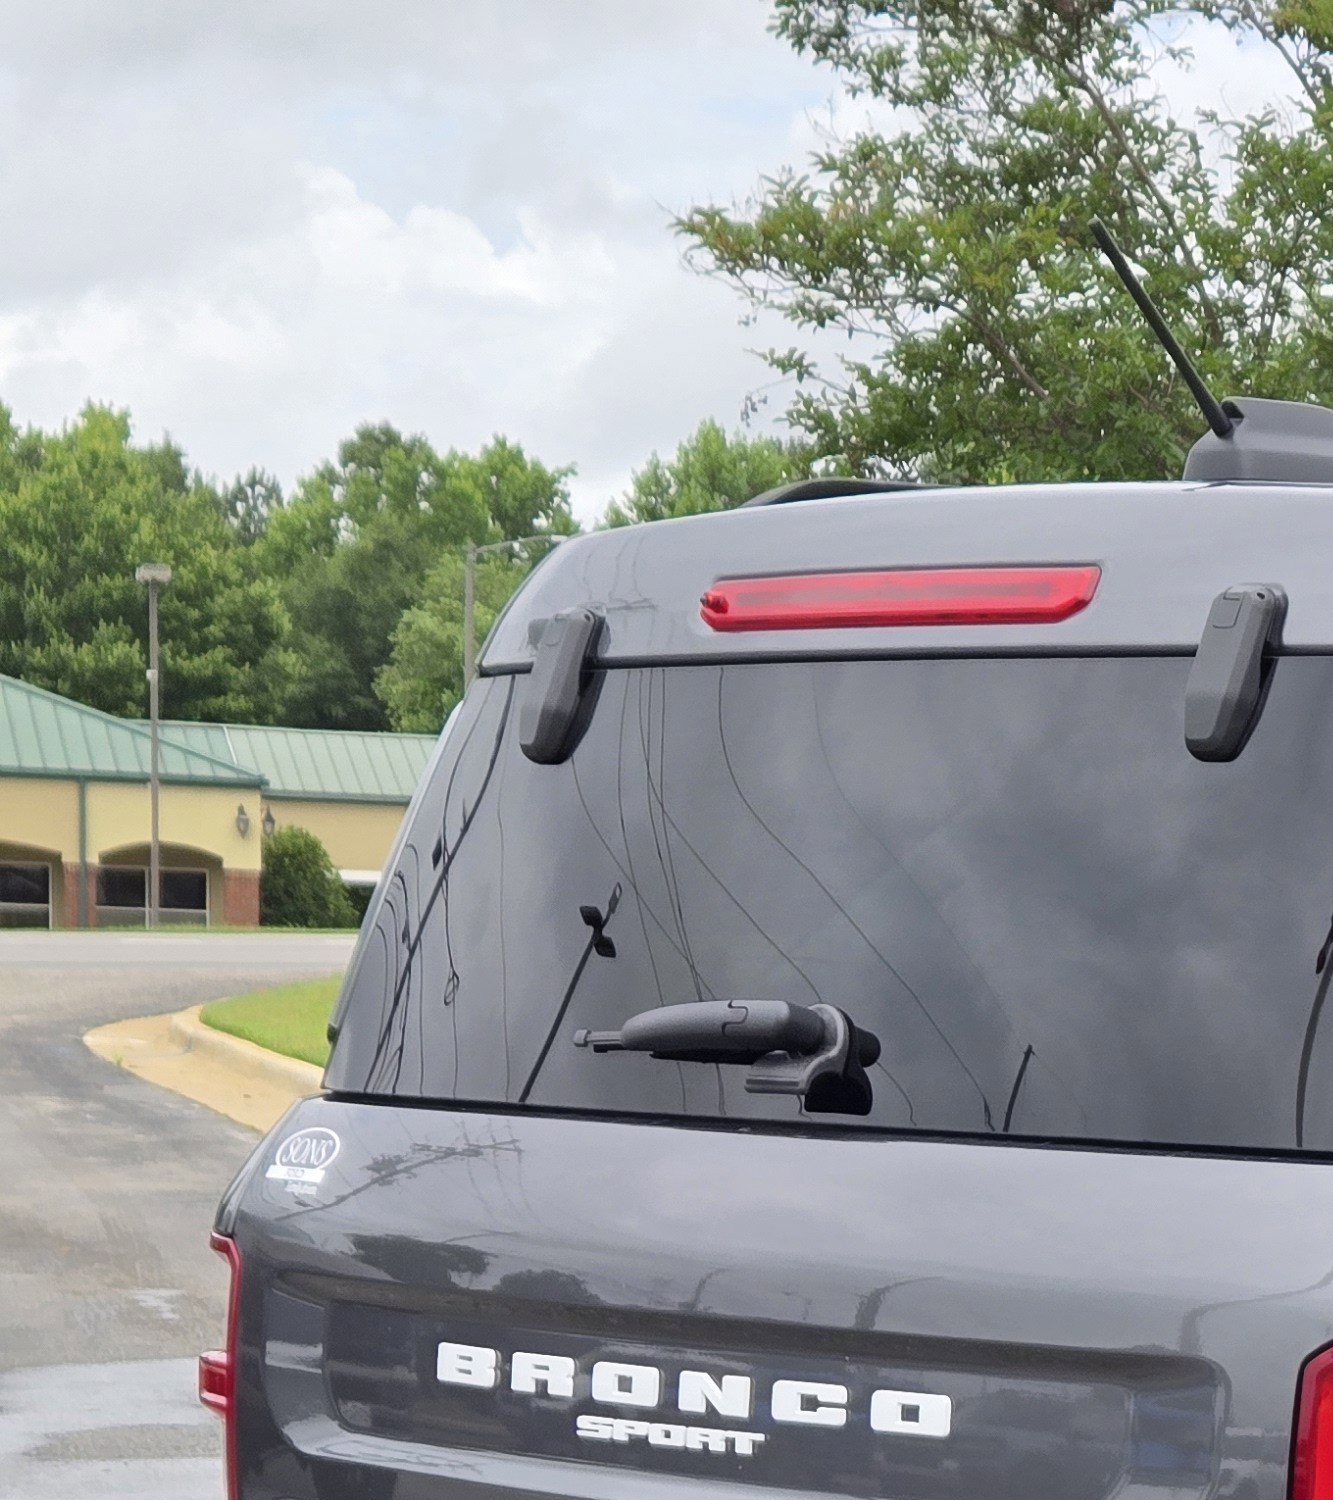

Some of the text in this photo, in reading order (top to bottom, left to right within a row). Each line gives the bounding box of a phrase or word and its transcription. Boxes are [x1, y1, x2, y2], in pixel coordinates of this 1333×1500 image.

[282, 1136, 334, 1166] SONS
[436, 1341, 953, 1438] BRONCO
[576, 1414, 769, 1456] SPORT
